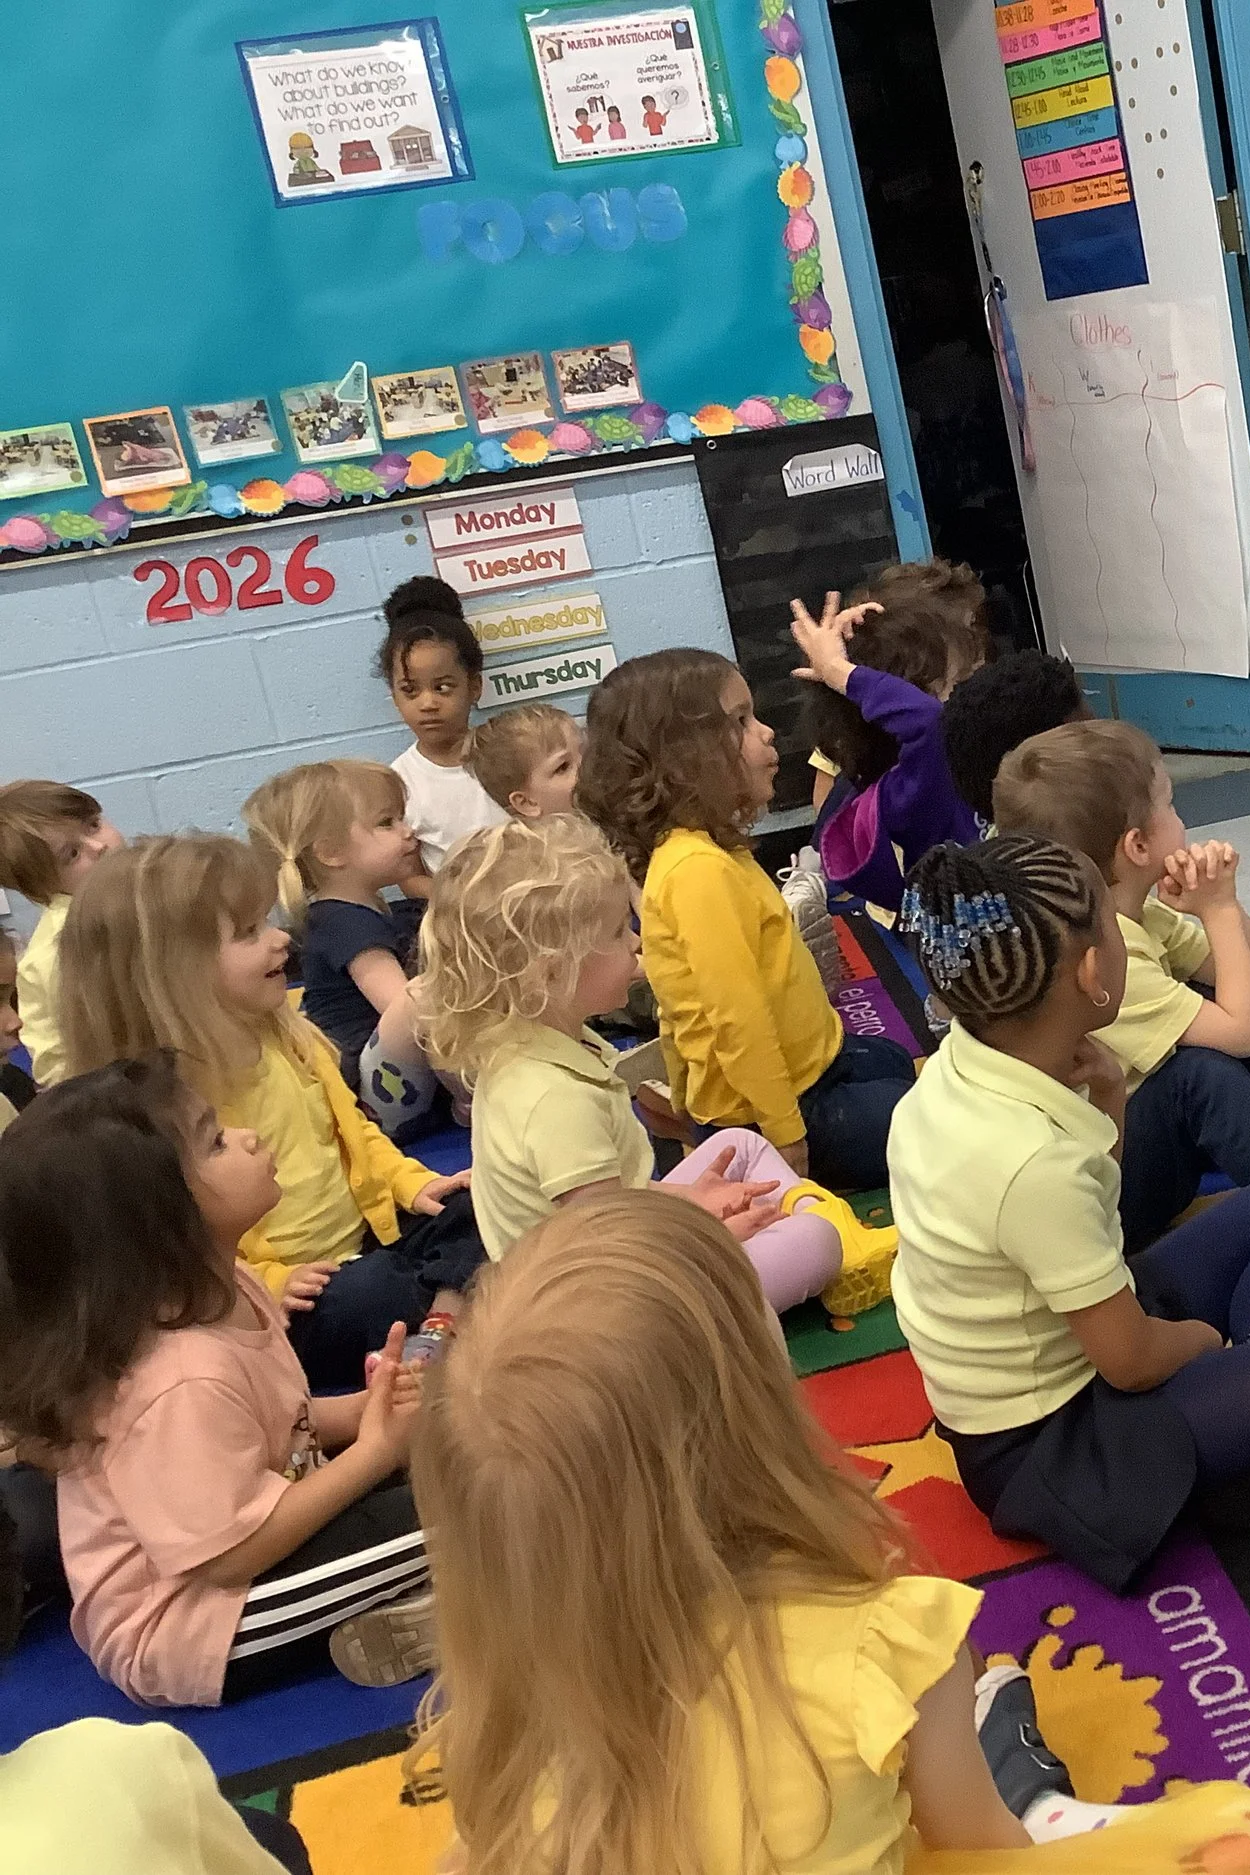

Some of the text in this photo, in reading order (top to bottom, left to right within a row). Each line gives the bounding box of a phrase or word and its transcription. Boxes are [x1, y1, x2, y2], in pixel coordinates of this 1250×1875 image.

[566, 29, 673, 51] NUESTRA INVESTIGACIÓN
[636, 63, 679, 75] queremos
[645, 54, 668, 65] ¿Qué
[268, 70, 312, 87] What
[318, 67, 338, 82] do
[340, 65, 366, 78] we
[283, 75, 407, 103] about buildings?
[566, 80, 610, 93] sabemos?
[575, 72, 598, 84] ¿Qué
[637, 71, 682, 85] averiguar?
[278, 92, 418, 121] What do we want
[307, 111, 400, 136] to find out?
[1070, 313, 1132, 346] Clothes
[786, 453, 878, 489] Word Wall
[455, 503, 555, 535] Monday
[464, 548, 565, 581] Tuesday
[133, 534, 336, 625] 2026
[489, 658, 601, 695] Thursday
[838, 987, 875, 1002] el
[836, 1000, 886, 1036] perro
